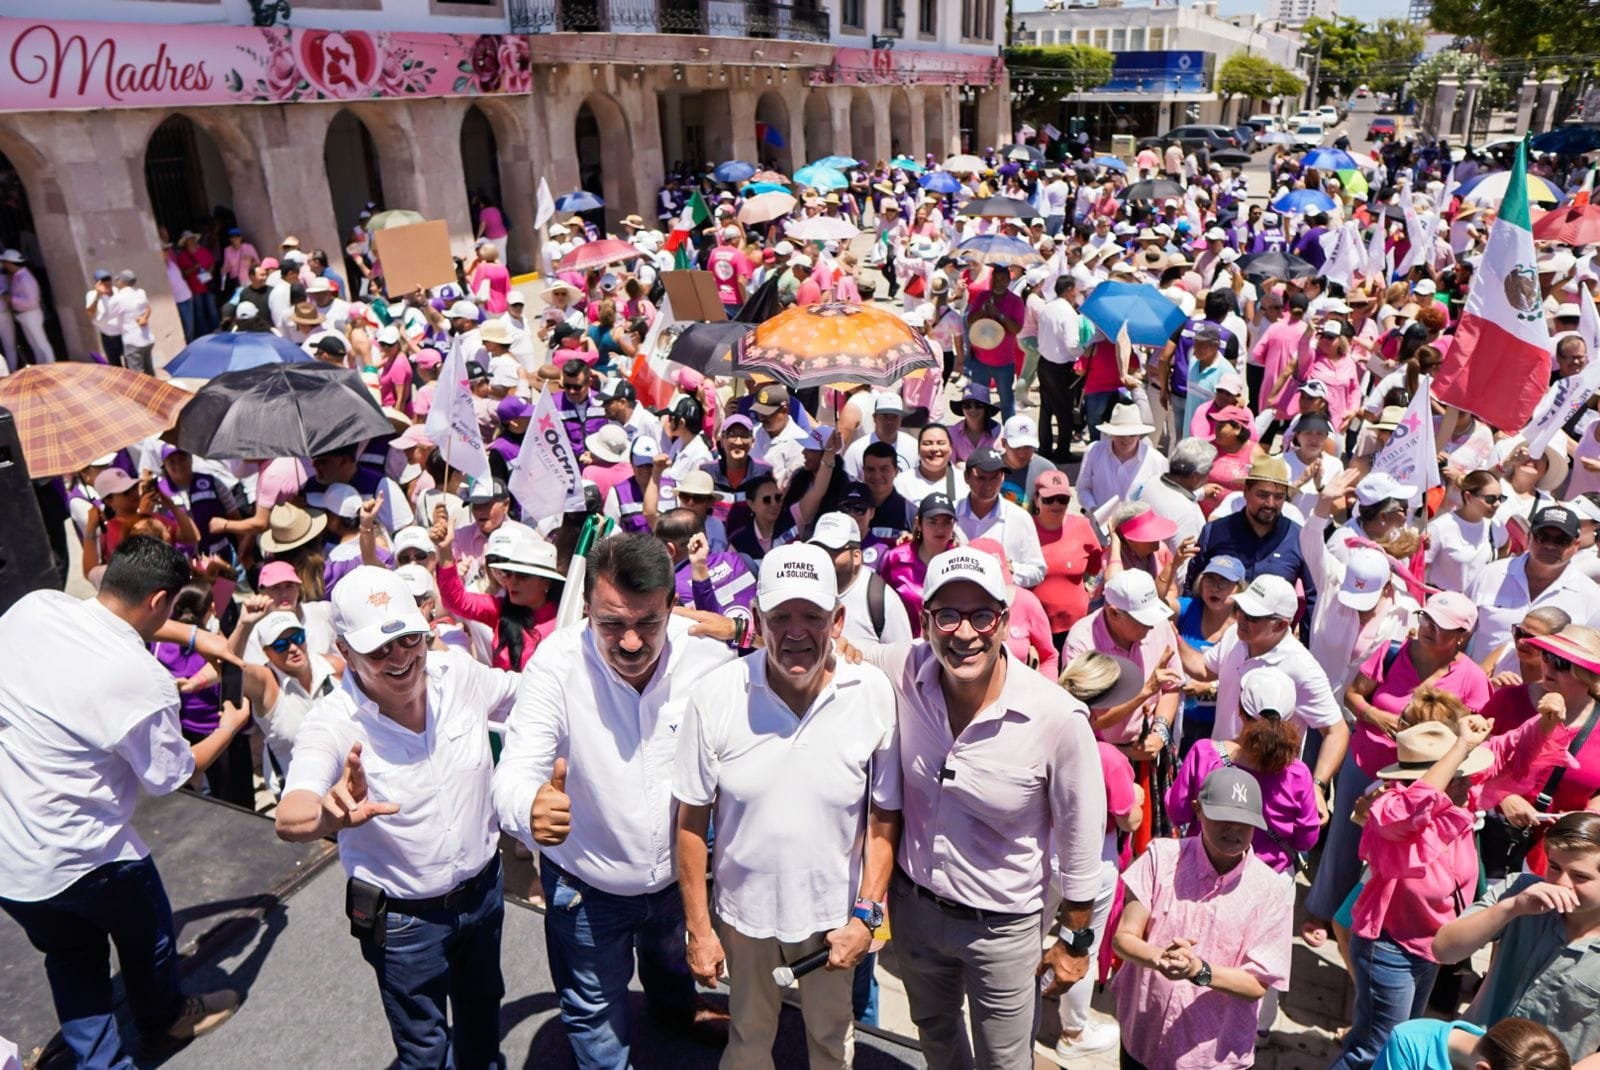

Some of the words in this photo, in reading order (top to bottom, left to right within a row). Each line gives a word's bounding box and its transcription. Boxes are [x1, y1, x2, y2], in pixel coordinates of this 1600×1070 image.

[10, 24, 214, 101] Madres
[783, 562, 805, 570] VOTAR
[941, 567, 949, 575] LA
[1231, 782, 1247, 803] NY
